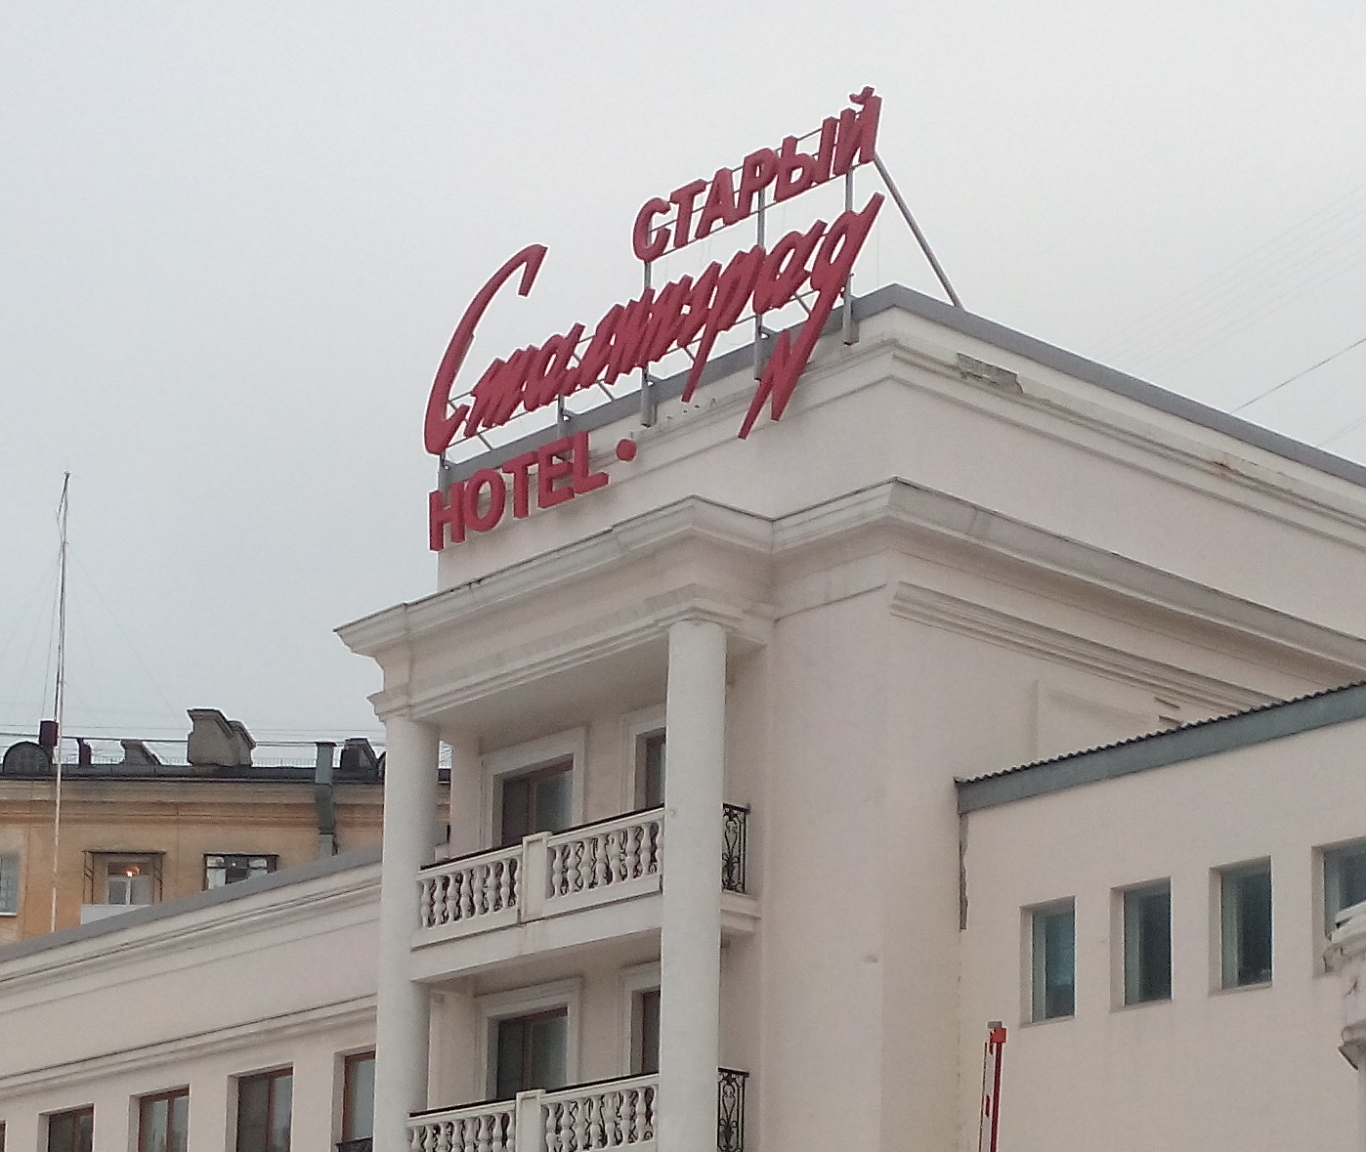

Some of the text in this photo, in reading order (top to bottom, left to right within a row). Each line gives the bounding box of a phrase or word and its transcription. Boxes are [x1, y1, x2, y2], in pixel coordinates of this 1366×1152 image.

[633, 86, 882, 262] СТАРЫЙ
[423, 193, 885, 455] Сталинград
[429, 431, 609, 552] HOTEL
